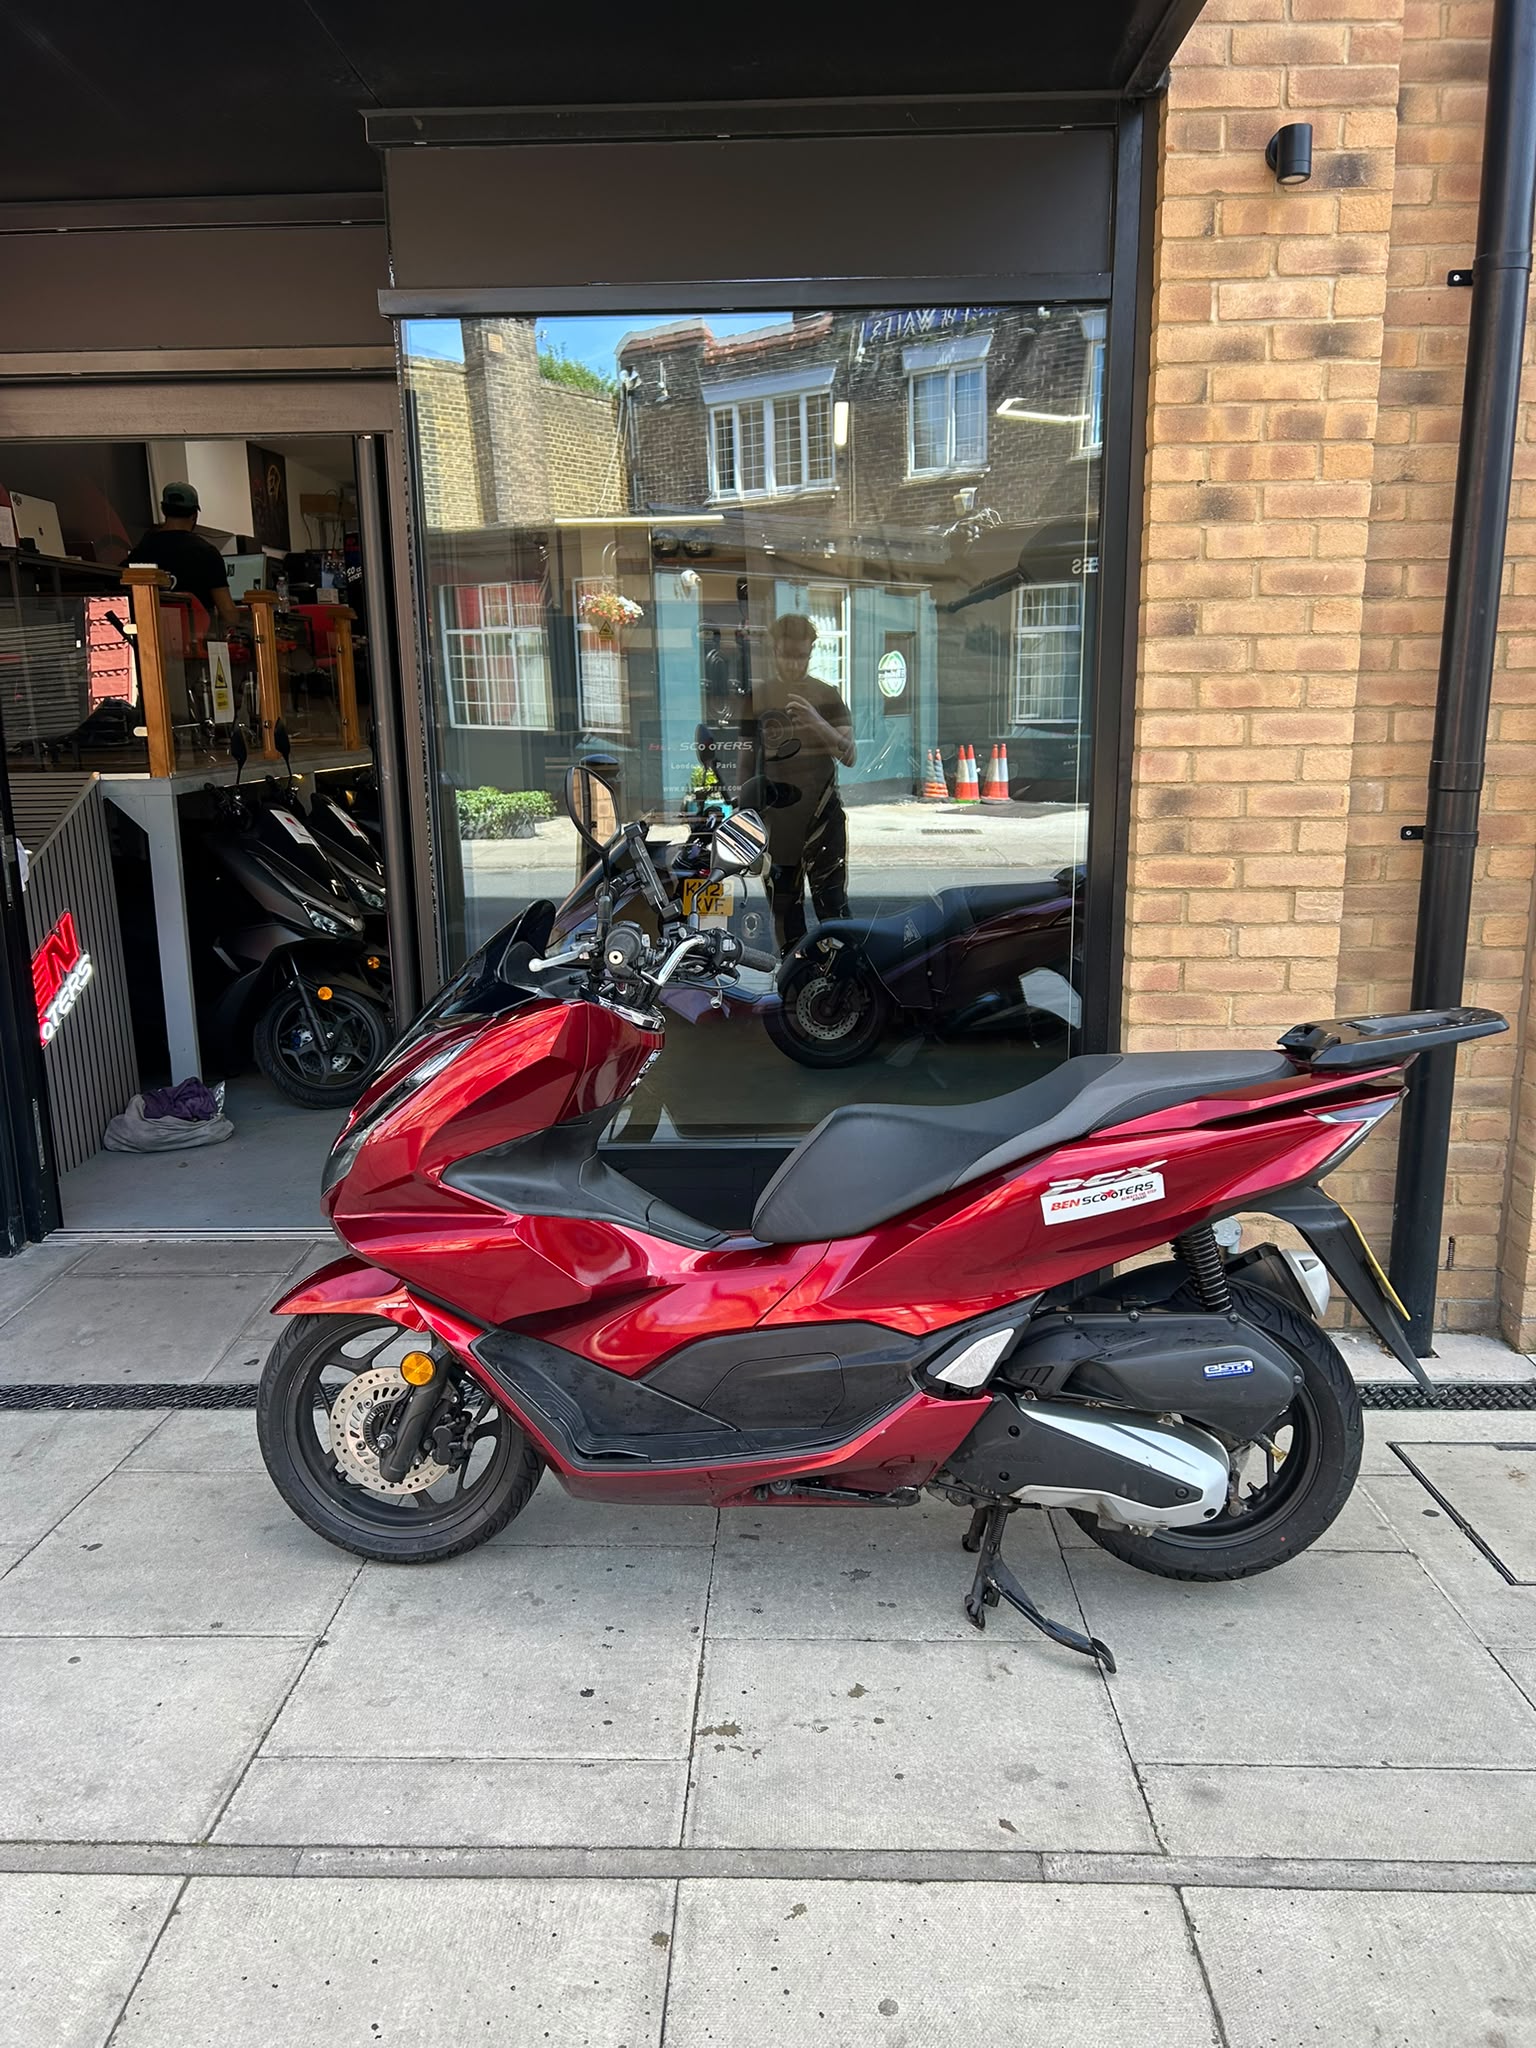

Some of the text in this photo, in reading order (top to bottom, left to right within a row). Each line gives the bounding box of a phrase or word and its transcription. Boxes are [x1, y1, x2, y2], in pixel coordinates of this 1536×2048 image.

[716, 761, 737, 769] Paris
[1051, 1180, 1155, 1212] BEN SCOOTERS
